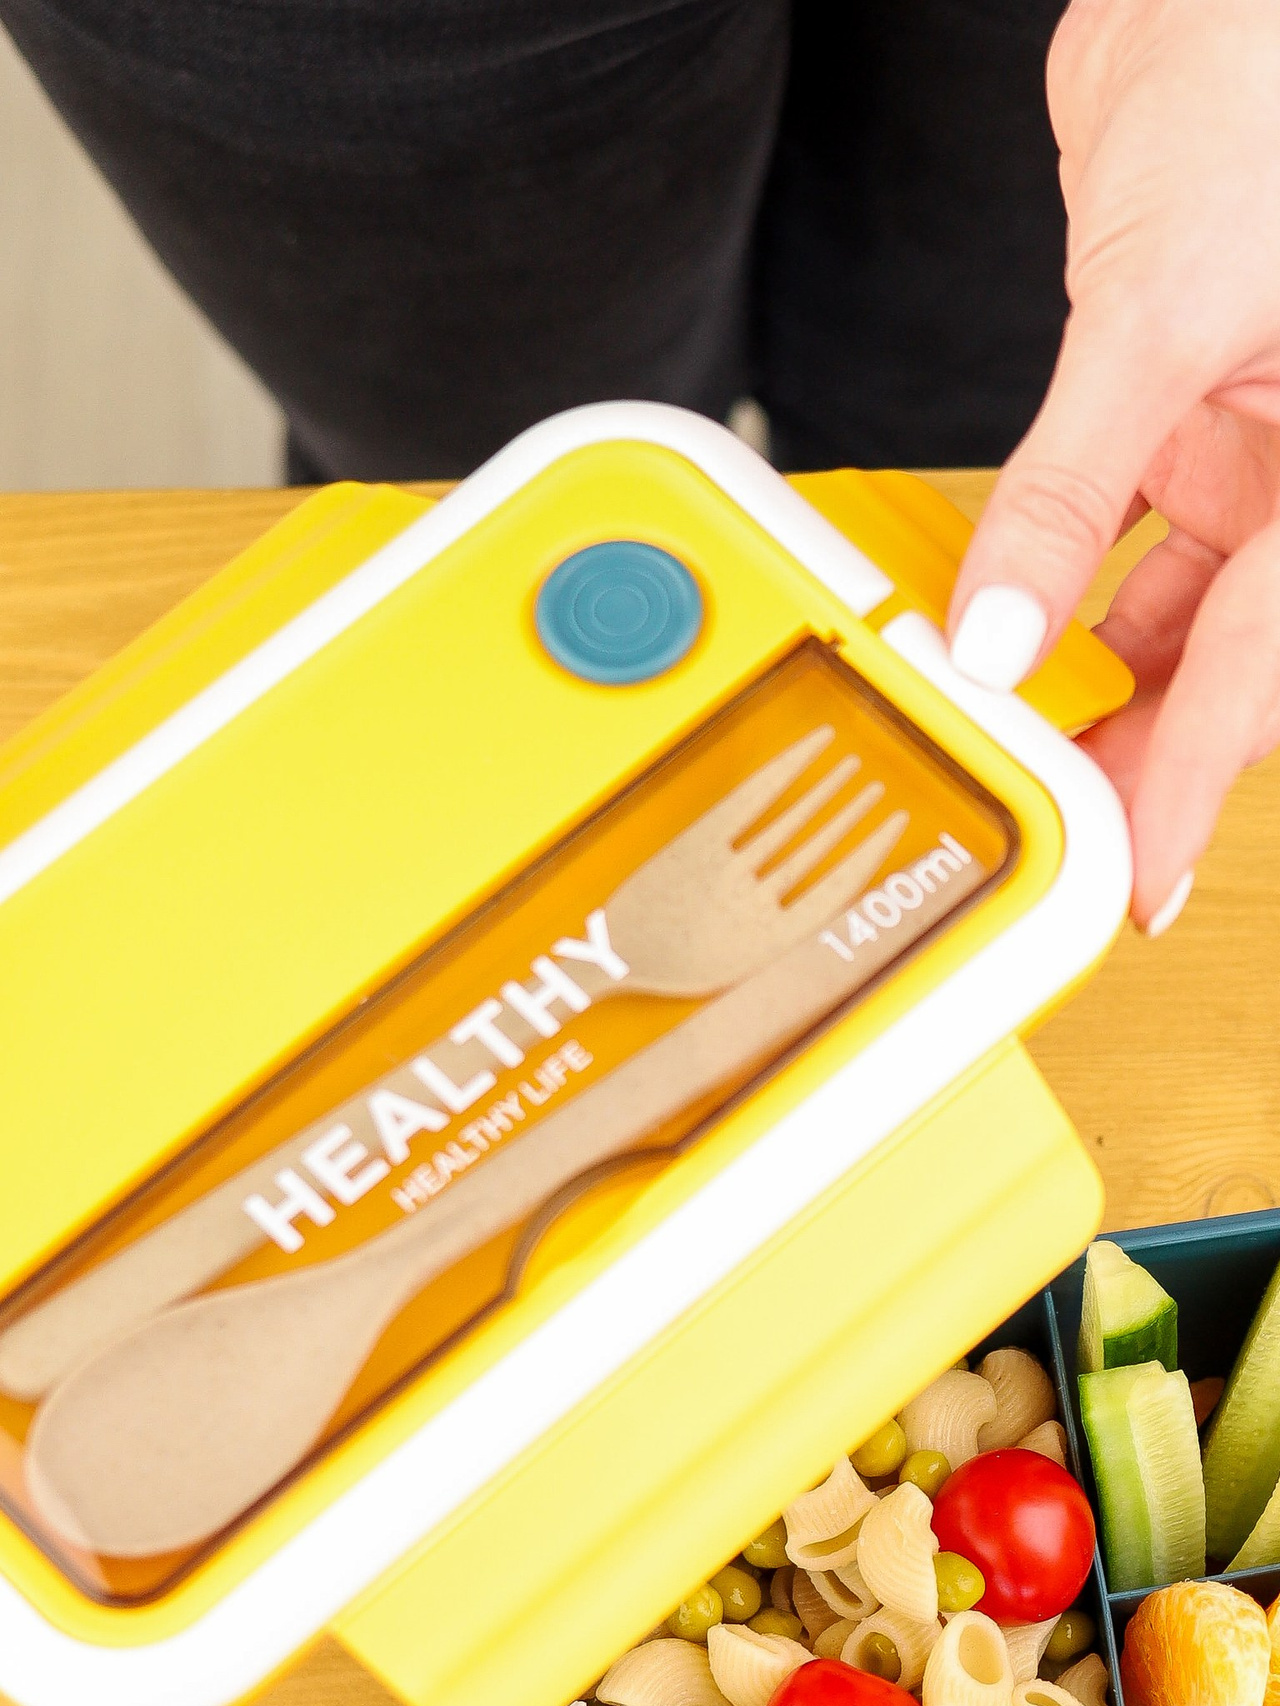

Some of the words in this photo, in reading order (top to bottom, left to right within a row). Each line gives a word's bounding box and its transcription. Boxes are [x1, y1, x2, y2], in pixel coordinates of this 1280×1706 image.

[817, 832, 972, 963] 1400ml
[243, 909, 631, 1254] HEALTHY
[390, 1090, 527, 1213] HEALTHY
[518, 1039, 594, 1106] LIFE
